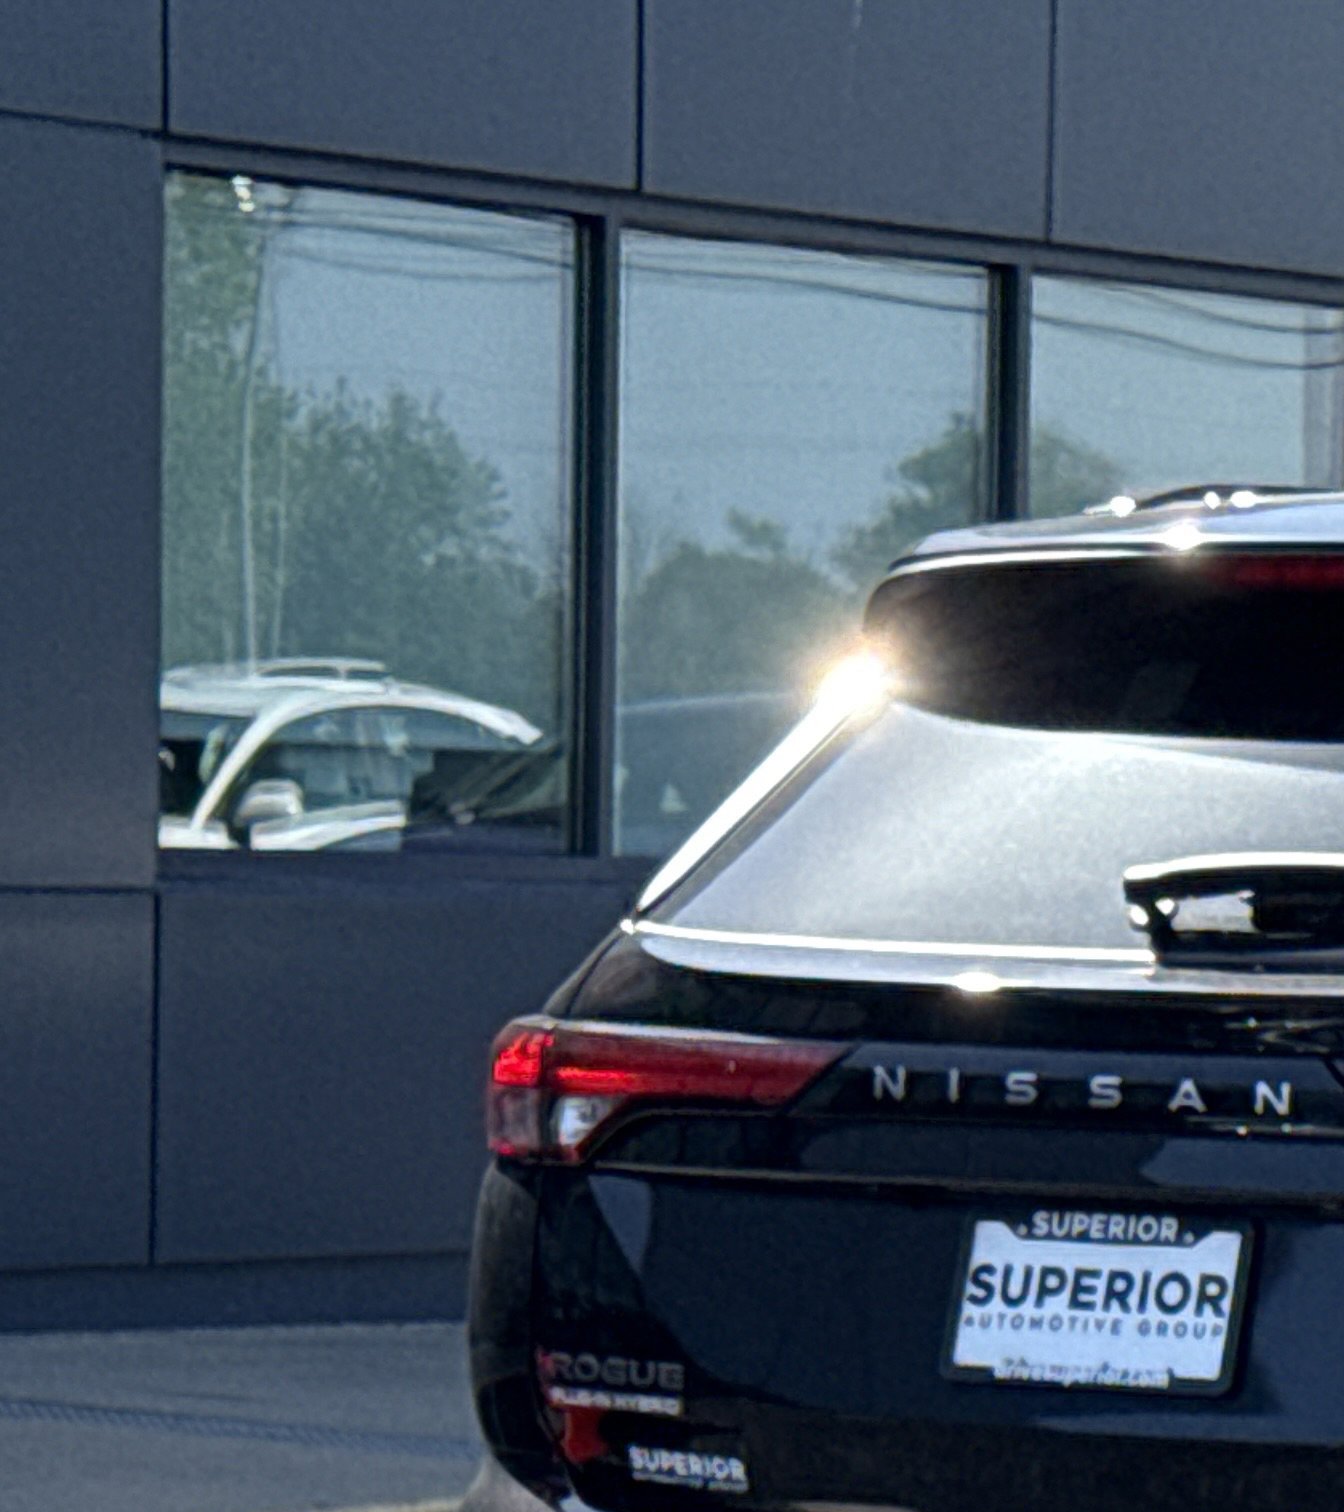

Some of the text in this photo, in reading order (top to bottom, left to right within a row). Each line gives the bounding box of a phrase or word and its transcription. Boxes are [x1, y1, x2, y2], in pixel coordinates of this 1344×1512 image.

[872, 1064, 1291, 1117] NISSAN
[1031, 1210, 1179, 1243] SUPERIOR
[966, 1263, 1230, 1318] SUPERIOR
[963, 1313, 1224, 1341] AUTOMOTIVE GROUP
[550, 1352, 685, 1391] ROGUE
[628, 1446, 746, 1480] SUPERIOR
